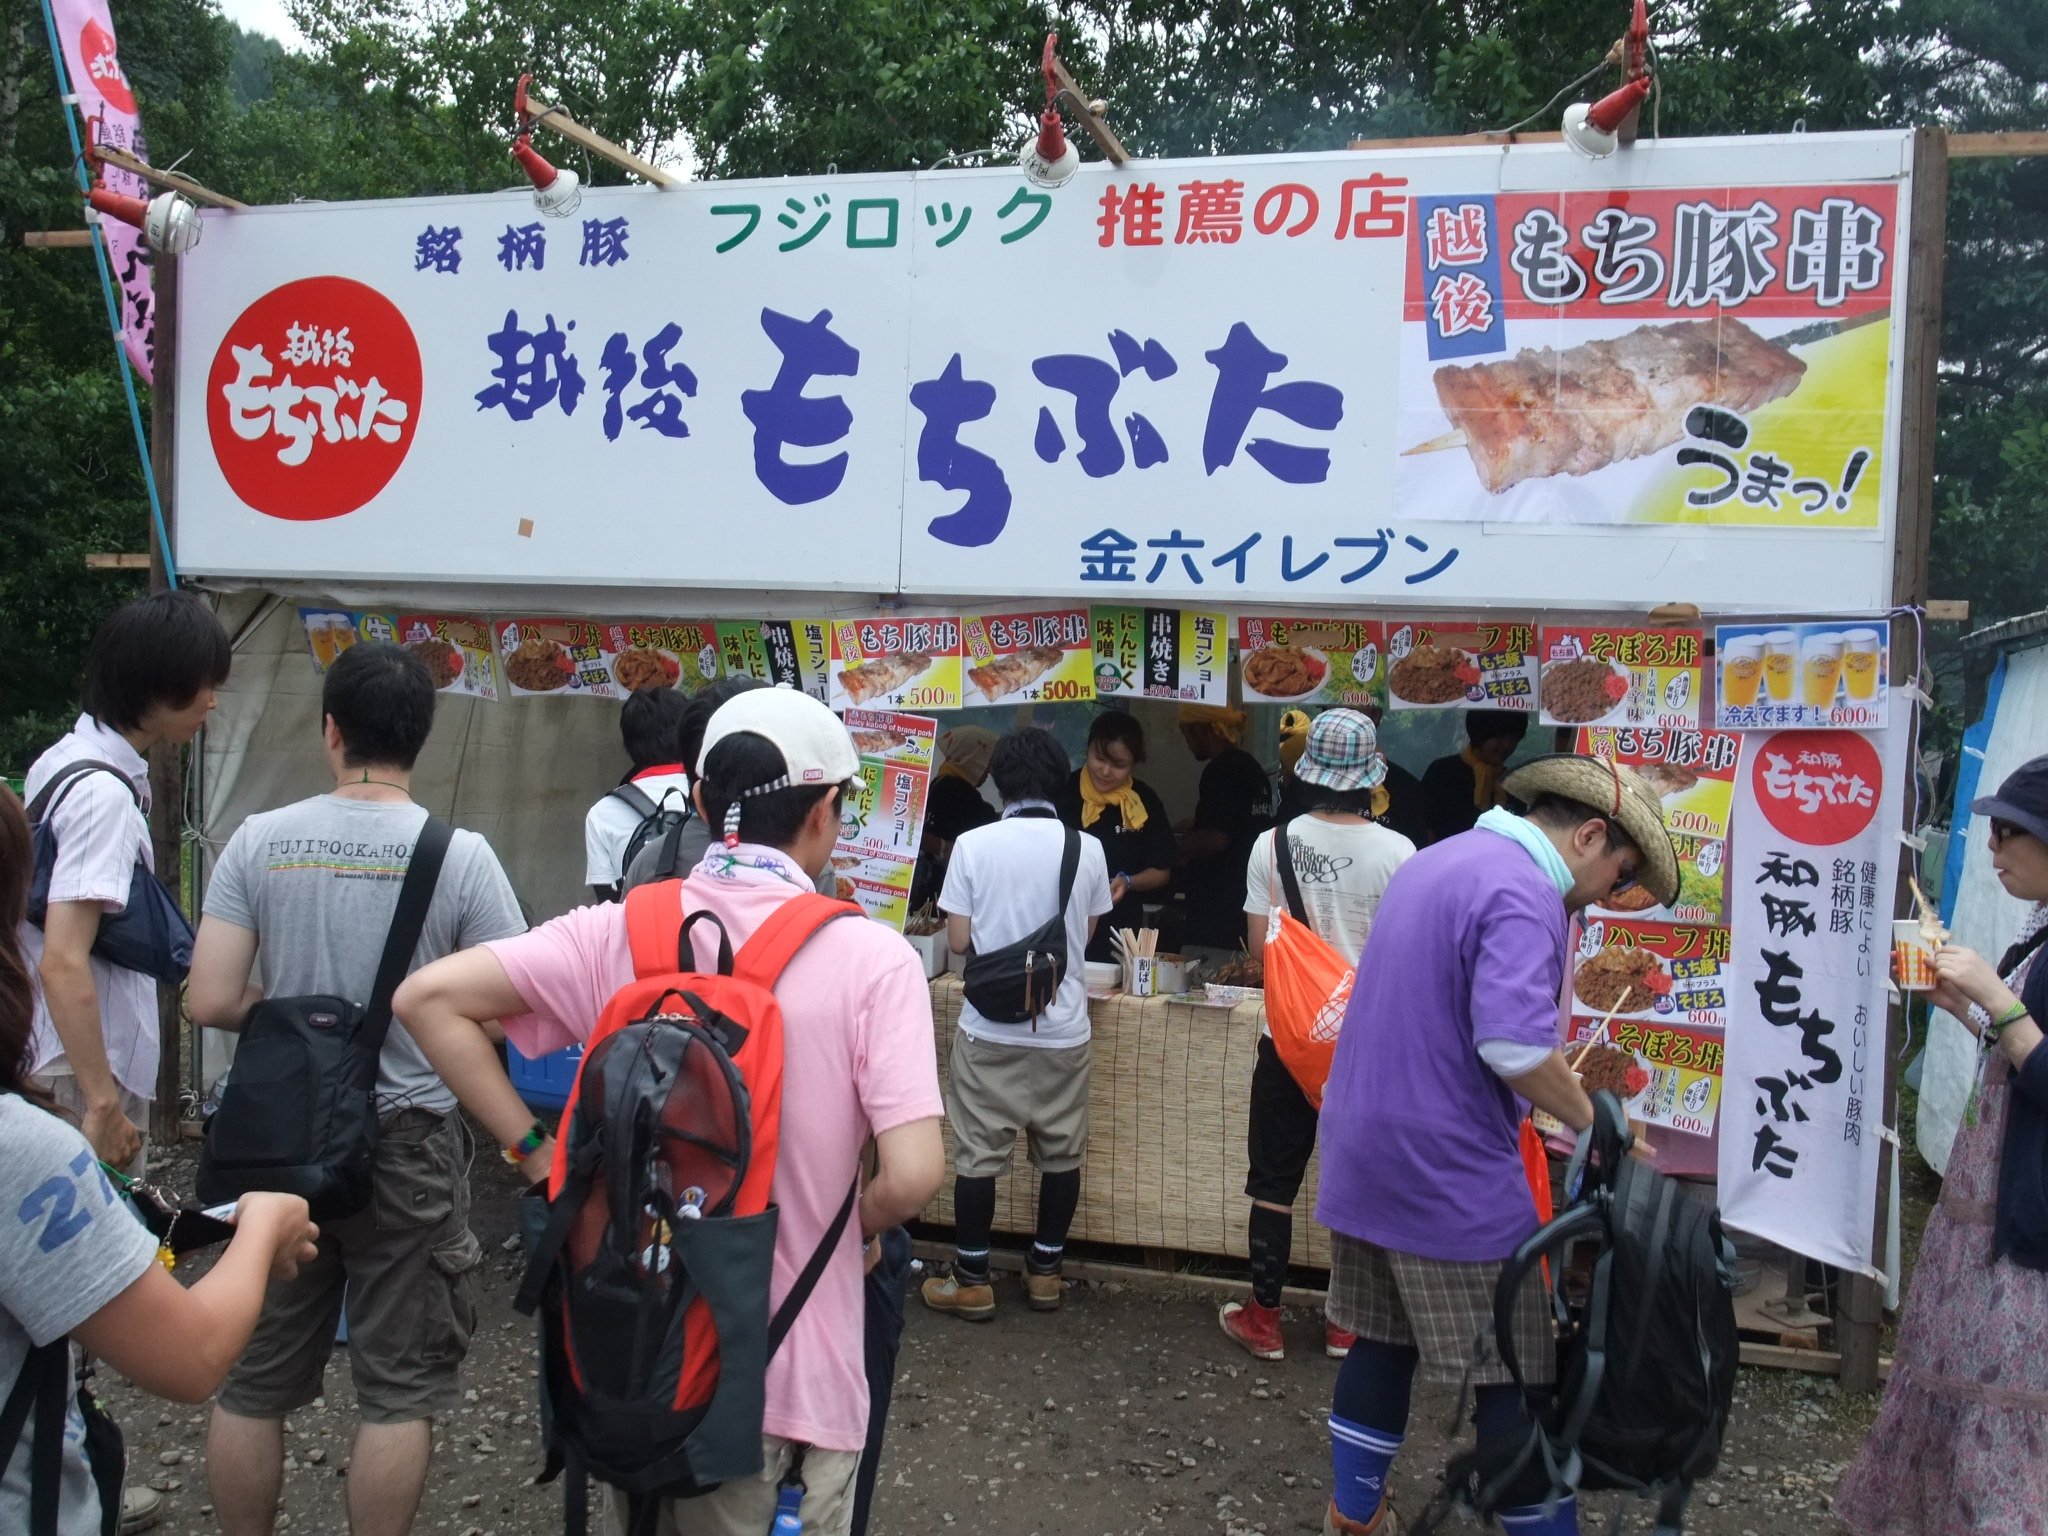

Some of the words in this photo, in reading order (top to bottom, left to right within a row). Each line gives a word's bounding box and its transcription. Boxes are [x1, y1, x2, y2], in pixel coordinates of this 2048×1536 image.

[709, 186, 1052, 253] フジロック
[1097, 173, 1408, 247] 推薦の店
[414, 217, 629, 274] 銘柄豚
[1509, 199, 1884, 308] もち豚串
[1425, 203, 1493, 339] 越後
[280, 321, 354, 367] 越後
[223, 343, 408, 467] もちぶた
[1676, 403, 1871, 515] うまっ!
[1080, 527, 1460, 585] 金六イレブン
[365, 616, 392, 641] 生
[521, 622, 601, 646] ハフ丼
[629, 626, 705, 650] もち豚丼
[861, 622, 958, 652] もち豚串
[990, 614, 1087, 648] もち豚串
[1096, 619, 1115, 658] 味噌
[1414, 622, 1533, 652] ハフ丼
[723, 635, 744, 670] 味噌
[742, 627, 766, 678] にんに
[771, 626, 797, 687] 串焼き
[805, 624, 828, 701] 塩コショー
[1120, 613, 1138, 690] にんにく
[1150, 613, 1173, 682] 串焼き
[1194, 617, 1215, 700] 塩コショー
[1588, 632, 1698, 666] そぼろ丼
[887, 694, 905, 706] 1本
[909, 686, 956, 706] 500円
[1022, 689, 1040, 701] 1本
[1042, 680, 1091, 700] 500円
[1341, 690, 1378, 706] 600円
[1488, 679, 1530, 697] そぼろ
[1497, 696, 1533, 710] 600円
[866, 720, 887, 731] kabob
[897, 725, 916, 735] brand
[917, 729, 933, 738] pork
[1658, 713, 1696, 728] 600円
[1725, 704, 1820, 724] 冷えてます!
[1831, 706, 1878, 724] 600円
[1615, 725, 1737, 771] もち豚串
[1796, 751, 1842, 768] 和豚
[1762, 751, 1874, 814] もちぶた
[893, 774, 913, 846] 塩コショー
[1669, 809, 1720, 834] 500円
[268, 839, 412, 859] FUJIROCKAHO
[862, 836, 890, 851] 500円
[876, 851, 895, 861] brand
[893, 890, 907, 898] pork
[1829, 858, 1856, 934] 銘柄豚
[1674, 906, 1716, 922] 600円
[1857, 861, 1877, 977] 健康によい
[1604, 925, 1730, 960] ハーフ丼
[1138, 959, 1150, 996] 割ばし
[1673, 958, 1717, 978] もち豚
[1678, 992, 1725, 1011] そぼろ
[1687, 1009, 1727, 1026] 600円
[1752, 851, 1842, 1178] 和豚もちぶた
[1615, 1022, 1724, 1072] そぼろ丼
[1844, 1004, 1868, 1146] おいしい豚肉
[1672, 1113, 1710, 1135] 600円
